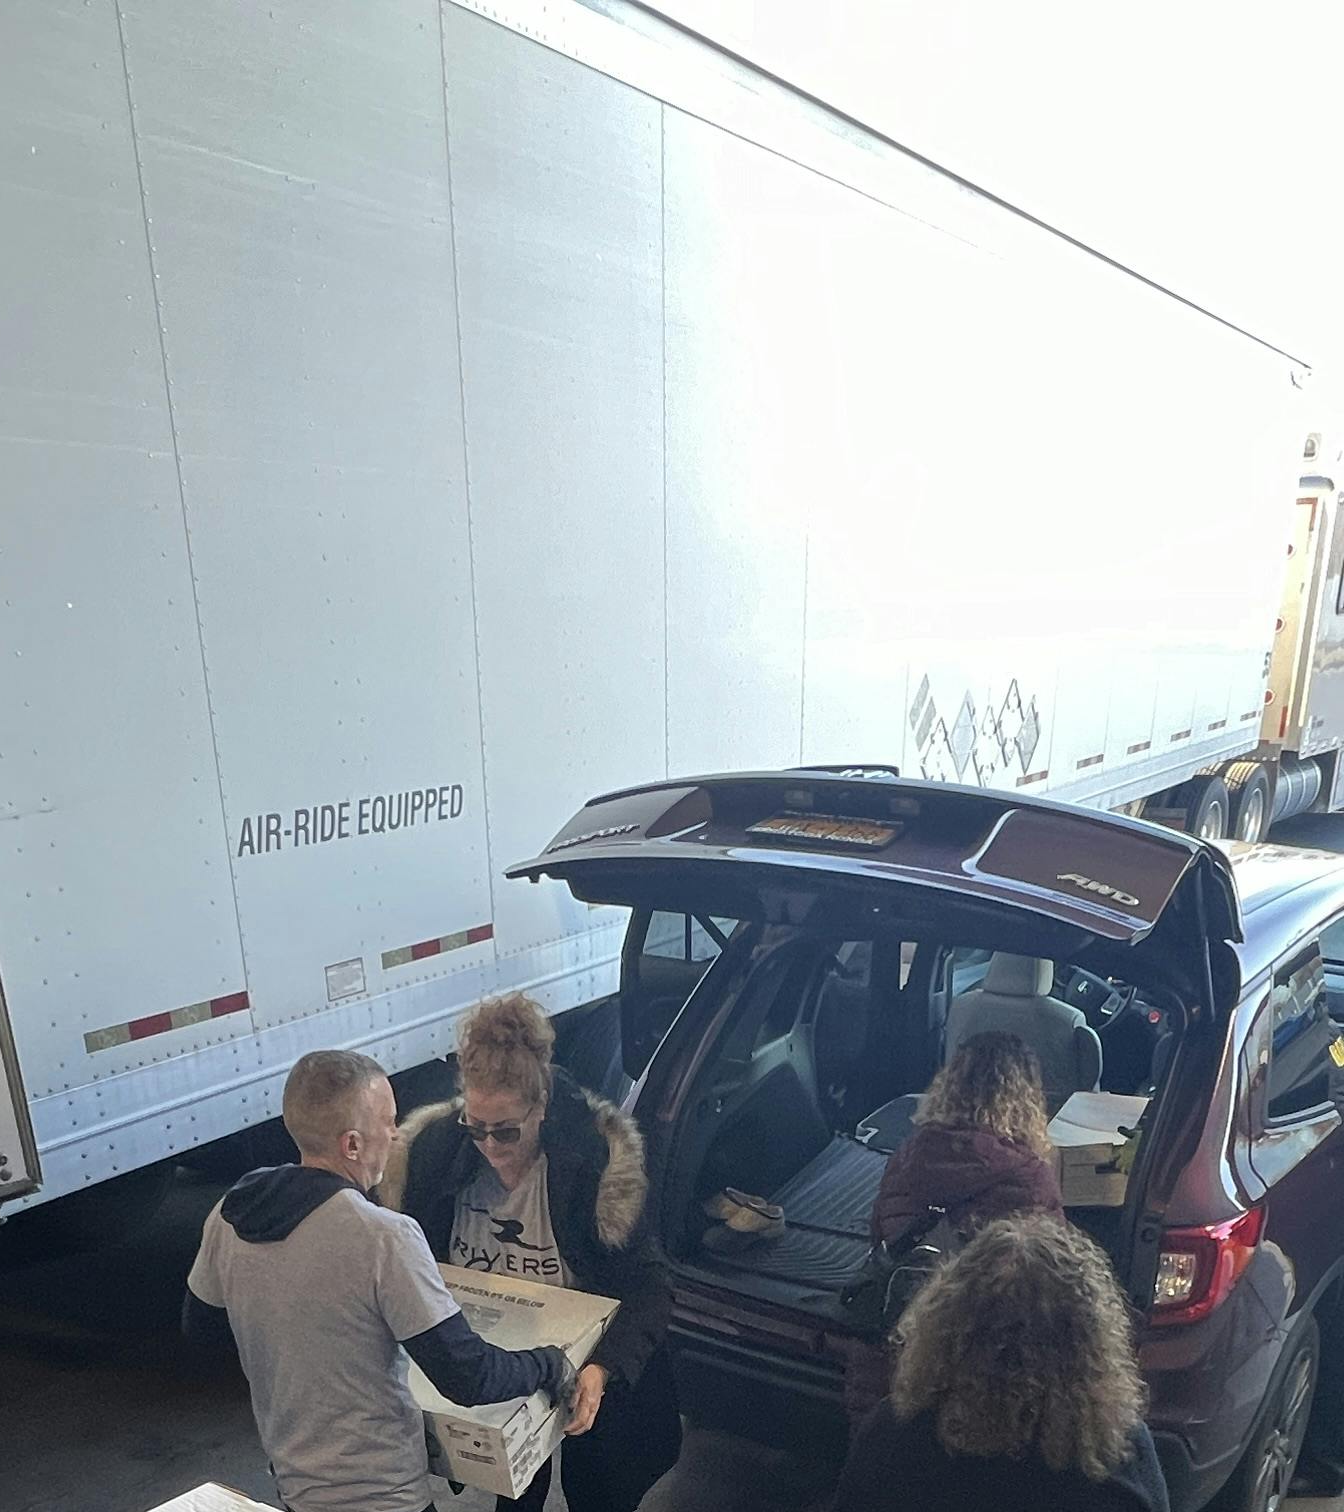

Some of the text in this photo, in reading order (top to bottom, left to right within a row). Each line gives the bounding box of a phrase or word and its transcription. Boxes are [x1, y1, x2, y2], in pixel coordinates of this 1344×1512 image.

[237, 783, 464, 858] AIR-RIDE EQUIPPED
[1056, 873, 1140, 906] AWD
[454, 1237, 560, 1276] RIVERS
